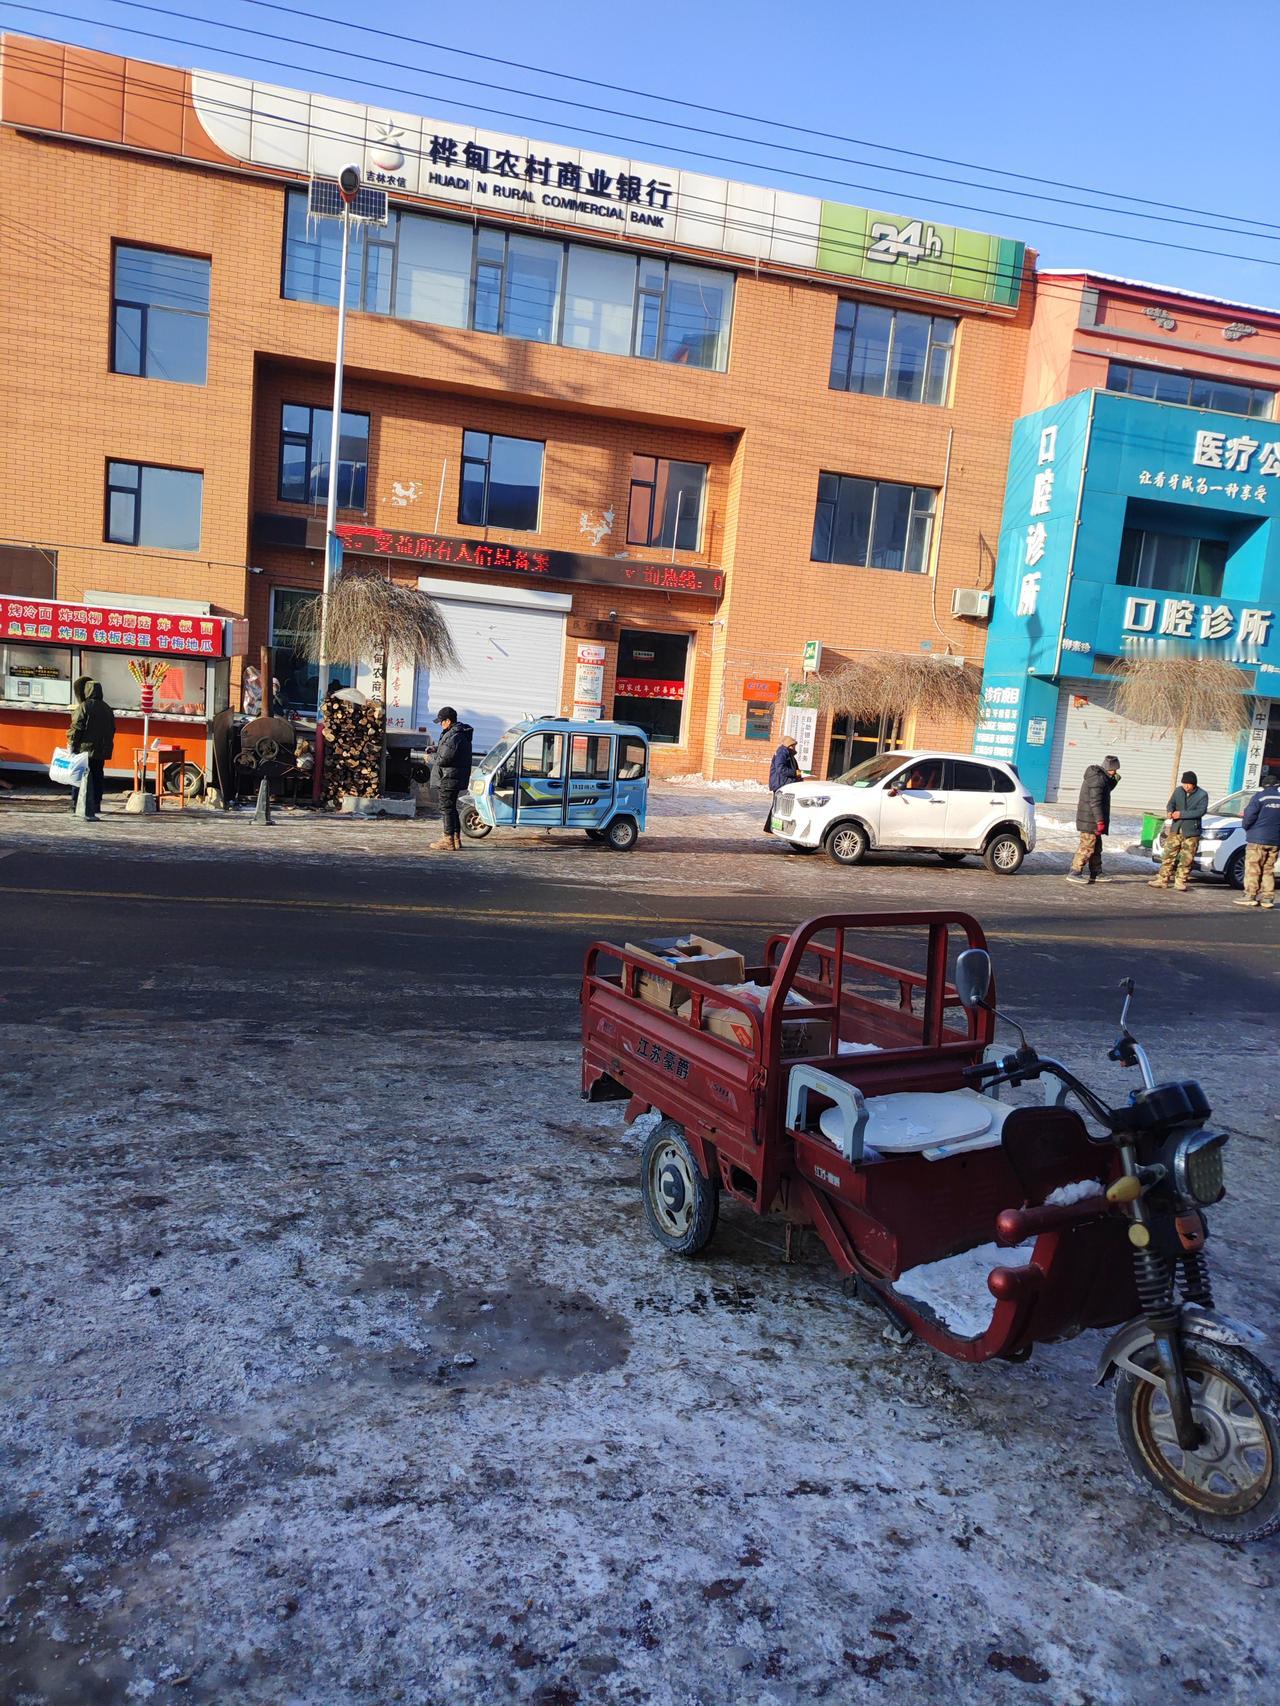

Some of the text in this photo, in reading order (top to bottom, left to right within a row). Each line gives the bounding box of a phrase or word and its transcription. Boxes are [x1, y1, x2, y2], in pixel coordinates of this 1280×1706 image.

[366, 171, 407, 188] 吉林农信
[428, 135, 673, 210] 桦甸农村商业银行
[493, 184, 536, 204] RURAL
[542, 194, 625, 222] COMMERCIAL
[630, 211, 664, 228] BANK
[866, 220, 942, 264] 24h
[1138, 470, 1268, 504] 让看牙成为一种享受
[1016, 424, 1059, 616] 口腔诊所
[8, 603, 53, 620] 烤冷面
[59, 608, 102, 626] 炸鸡柳
[1121, 596, 1272, 646] 口腔诊所
[8, 622, 214, 652] 臭豆腐 炸肠 铁板实蛋 甘梅地瓜
[636, 1037, 690, 1080] 江苏豪爵
